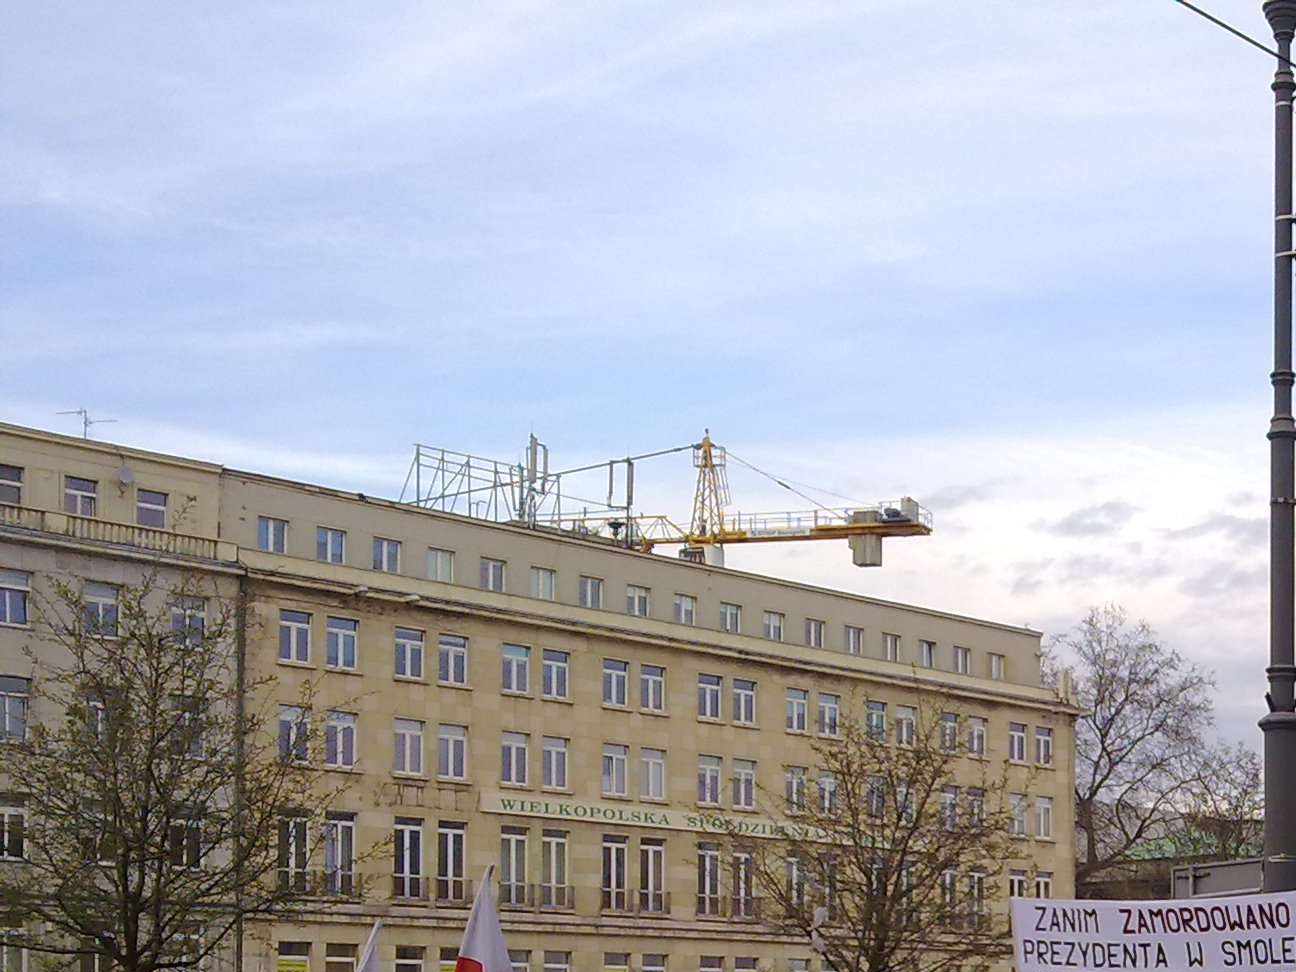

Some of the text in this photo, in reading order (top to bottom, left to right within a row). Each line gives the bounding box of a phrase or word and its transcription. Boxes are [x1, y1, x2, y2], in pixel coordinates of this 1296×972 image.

[500, 798, 671, 825] WIELKOPOLSKA
[1033, 901, 1291, 935] ZANIM ZAMORDOWANO
[1023, 939, 1169, 969] PREZYDENTA
[1186, 940, 1205, 968] W
